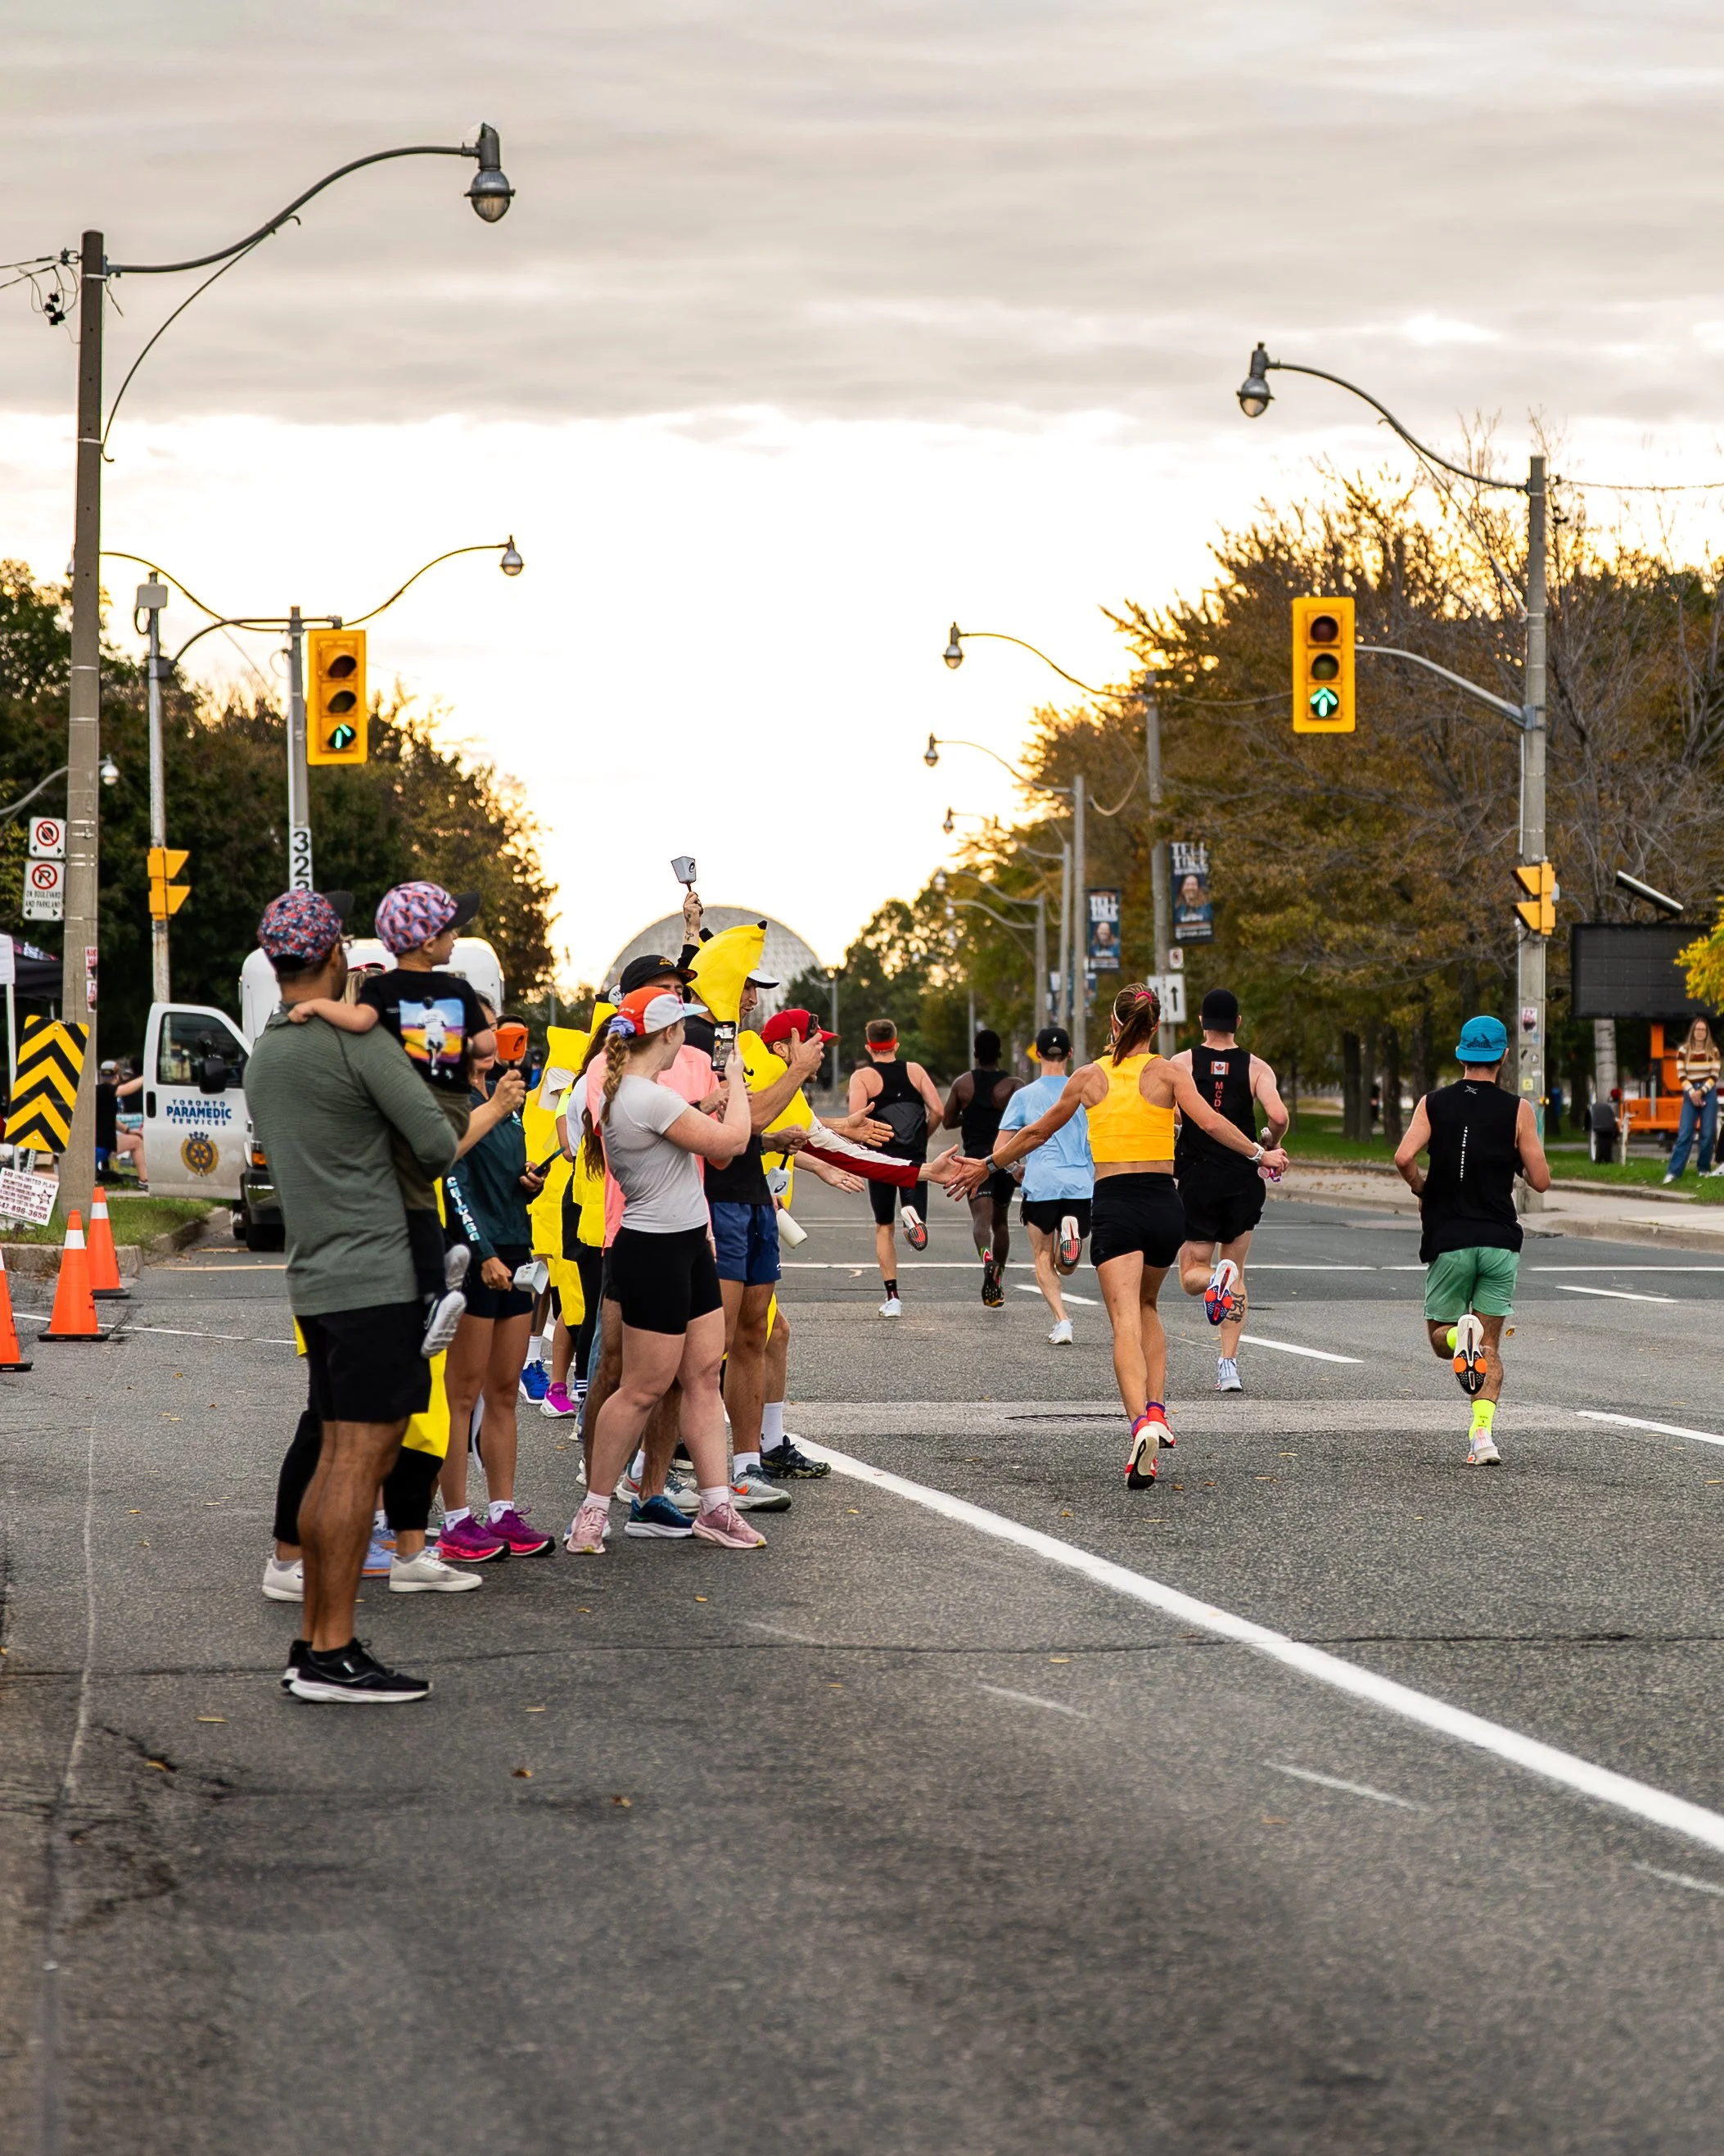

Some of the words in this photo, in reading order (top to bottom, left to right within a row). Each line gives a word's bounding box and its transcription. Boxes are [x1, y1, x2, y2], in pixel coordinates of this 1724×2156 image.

[34, 890, 61, 898] BOULEVARD
[172, 1099, 225, 1107] TORONTO
[166, 1105, 232, 1119] PARAMEDIC
[172, 1118, 226, 1126] SERVICES
[15, 1174, 41, 1185] UNLIMITED
